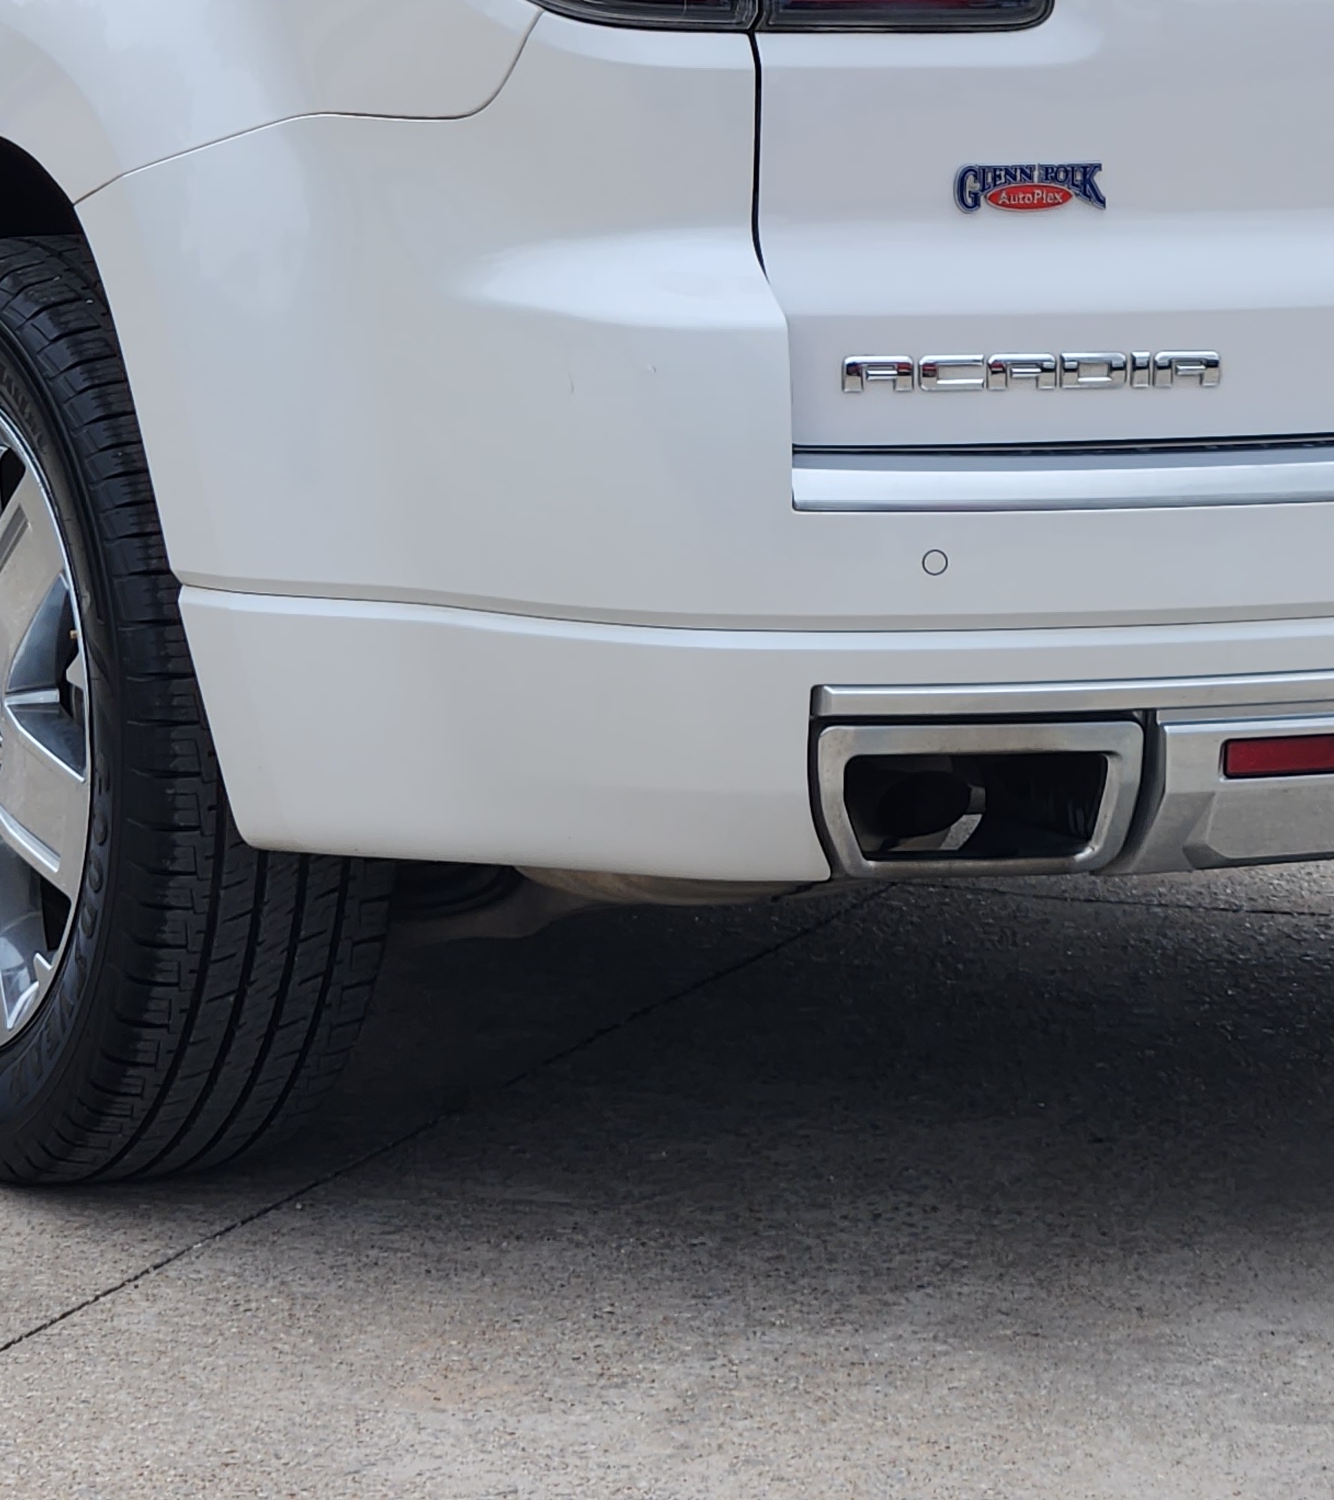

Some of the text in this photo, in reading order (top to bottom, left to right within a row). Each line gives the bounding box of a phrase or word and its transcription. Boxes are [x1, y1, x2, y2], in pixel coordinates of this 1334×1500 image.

[953, 161, 1107, 214] GLENN POLK
[998, 189, 1064, 205] AutoPlex
[840, 349, 1221, 394] ACADIA
